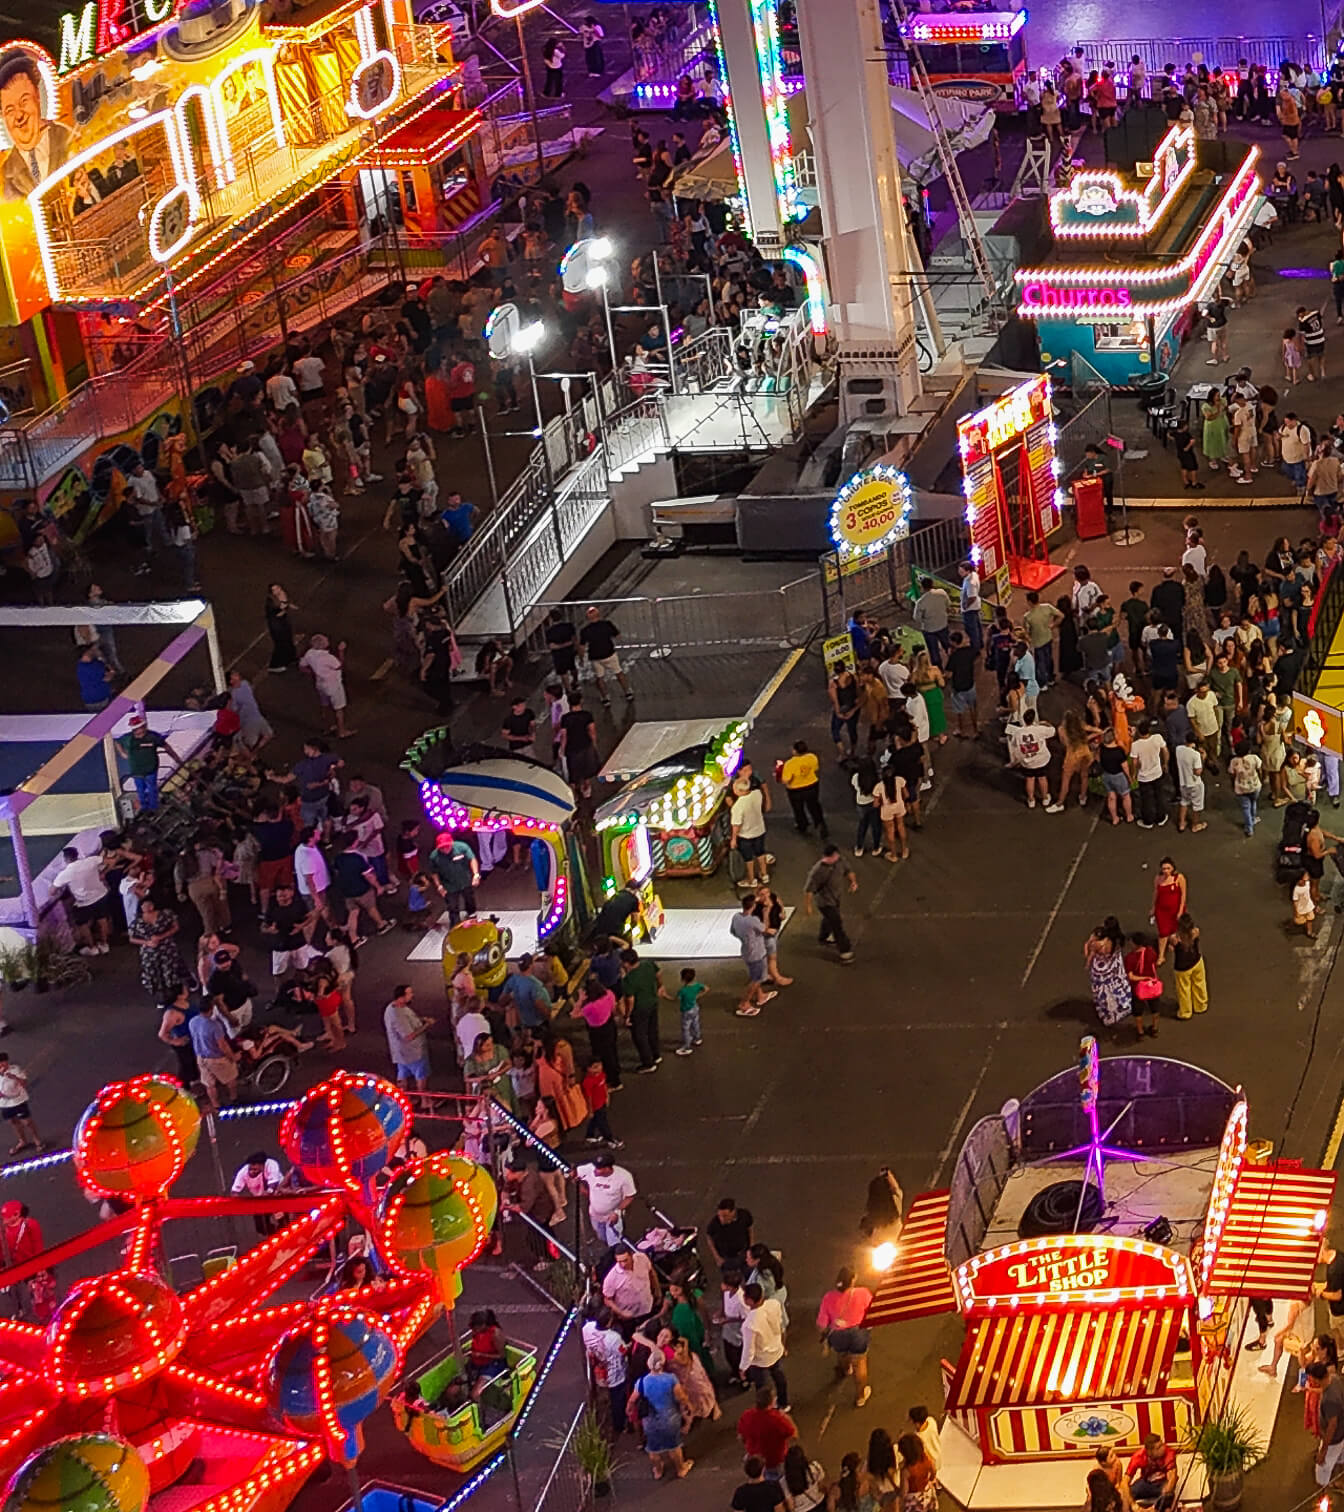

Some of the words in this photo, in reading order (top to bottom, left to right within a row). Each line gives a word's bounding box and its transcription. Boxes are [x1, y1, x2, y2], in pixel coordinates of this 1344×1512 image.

[1022, 283, 1132, 308] Churros
[857, 500, 888, 518] COPOS
[845, 512, 857, 530] 3
[863, 510, 895, 531] 40,00
[1008, 1248, 1109, 1288] LITTLE
[1028, 1251, 1062, 1267] THE
[1049, 1269, 1109, 1292] SHOP
